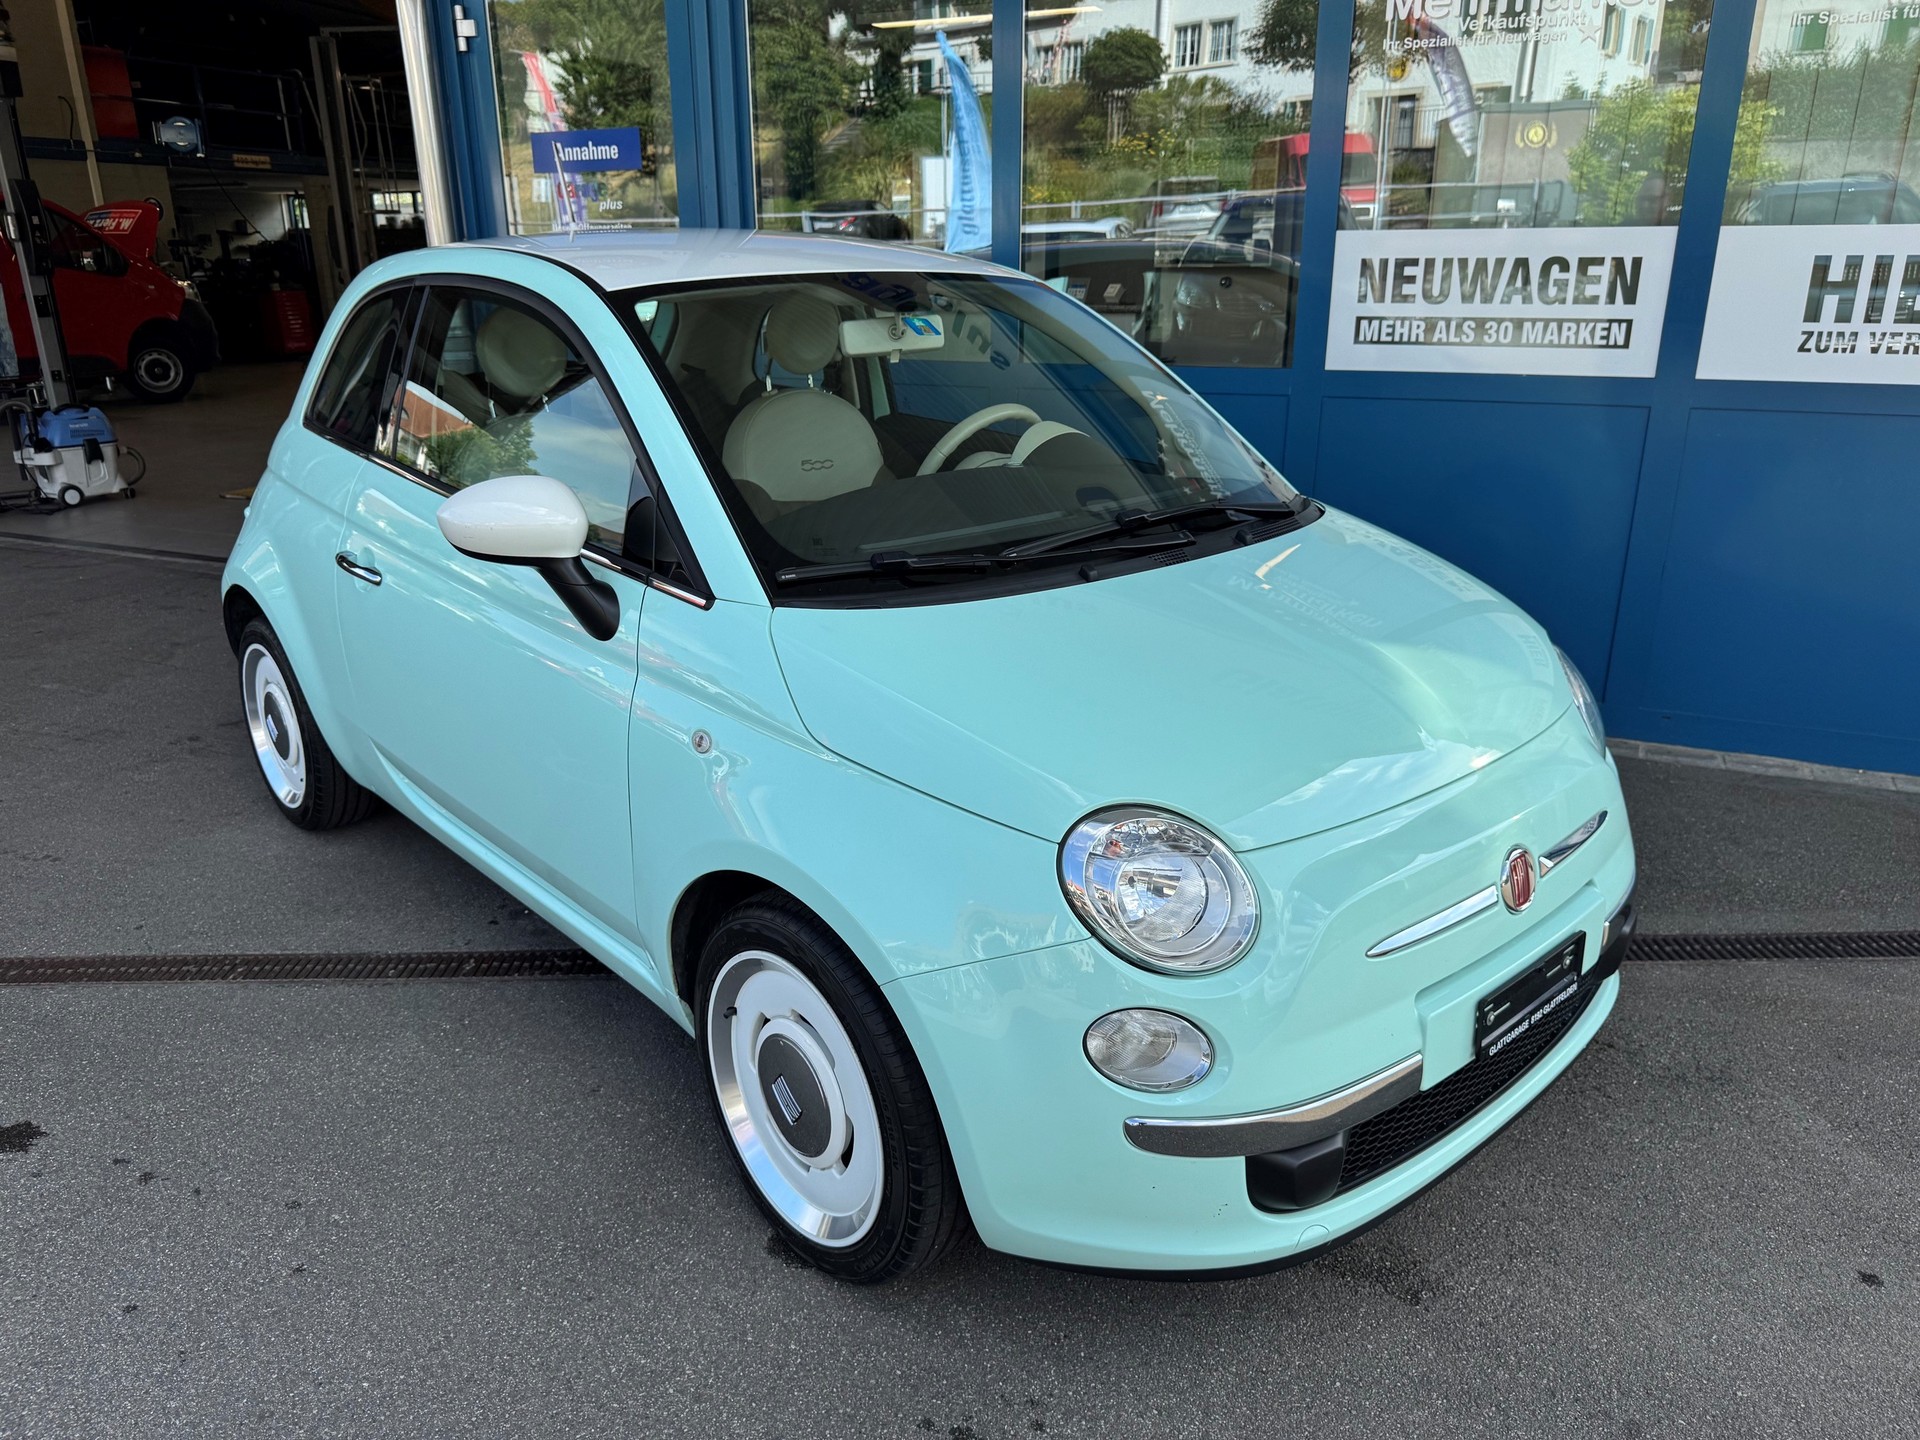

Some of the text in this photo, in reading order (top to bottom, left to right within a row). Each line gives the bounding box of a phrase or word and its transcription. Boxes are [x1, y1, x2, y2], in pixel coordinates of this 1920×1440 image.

[1459, 11, 1587, 32] Verkaufspunkt
[1791, 5, 1920, 27] Ihr Spezialist fü
[1383, 30, 1568, 51] Ihr Spezialist für Neuwagen
[554, 140, 619, 162] Annahme
[599, 199, 623, 213] plus
[1357, 256, 1643, 305] NEUWAGEN
[1359, 319, 1627, 345] MEHR ALS 30 MARKEN
[1797, 331, 1920, 355] ZUM VER
[801, 459, 834, 472] 500
[1489, 982, 1578, 1057] GLATTGARAGE 8192 GLATTFELDEN
